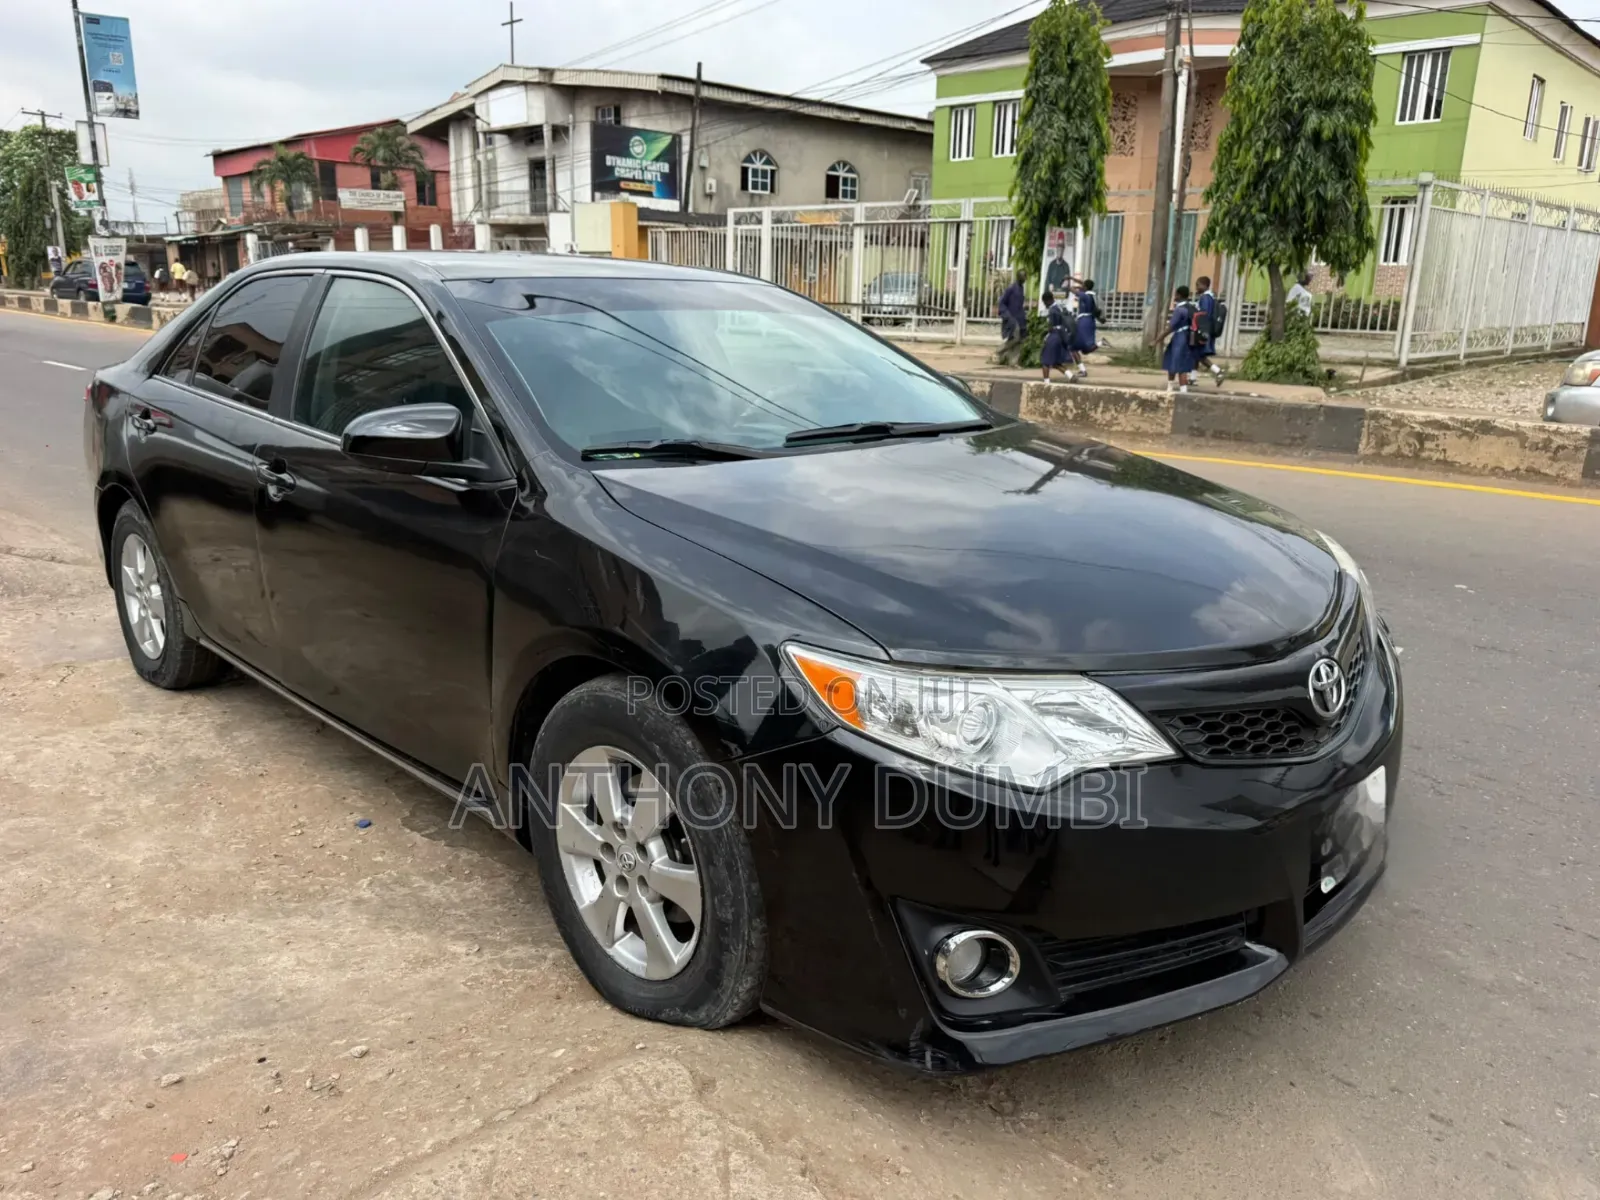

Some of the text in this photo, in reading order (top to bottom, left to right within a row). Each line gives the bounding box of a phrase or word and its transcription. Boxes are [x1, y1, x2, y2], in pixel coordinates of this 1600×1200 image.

[605, 155, 670, 173] DYNAMIC PRAYER
[614, 167, 643, 180] CHAPEL
